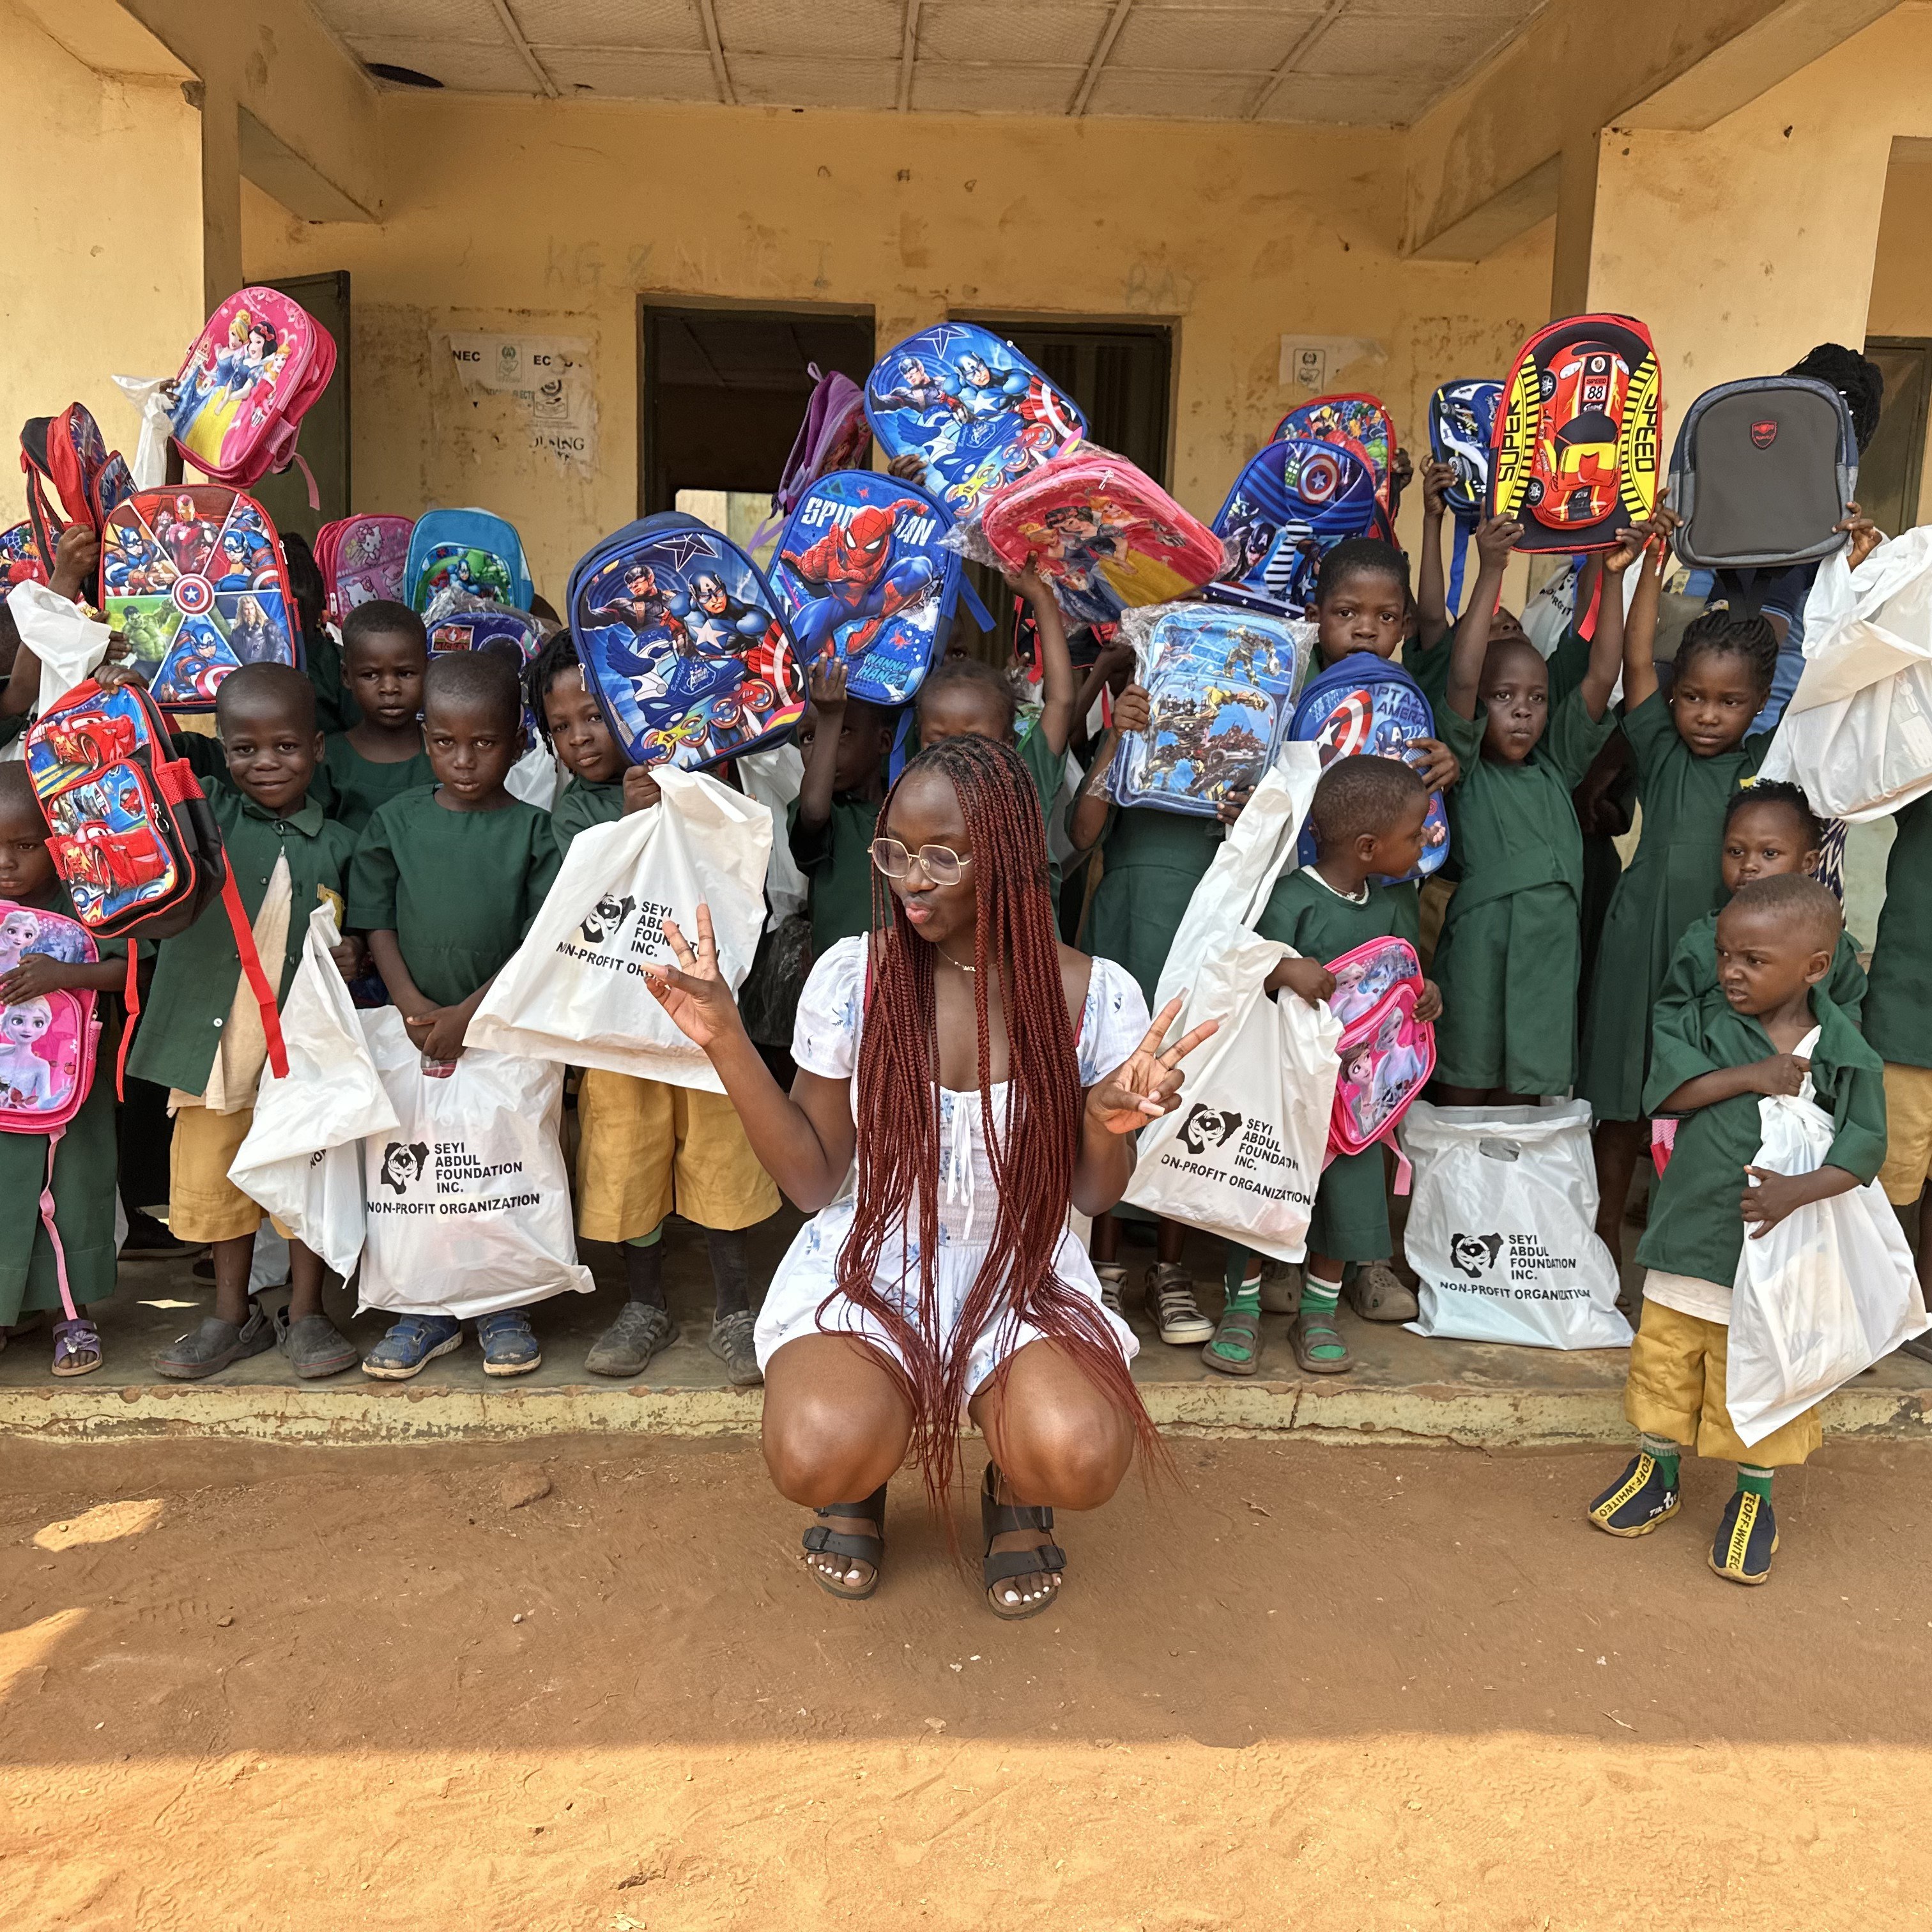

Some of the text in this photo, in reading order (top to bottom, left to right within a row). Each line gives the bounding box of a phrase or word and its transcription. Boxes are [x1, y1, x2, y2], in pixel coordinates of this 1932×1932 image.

[1587, 386, 1603, 399] 88
[1498, 399, 1521, 482] SUPER
[1634, 393, 1659, 473] SPEED
[866, 652, 908, 672] WANNA
[857, 665, 907, 687] HANG?
[641, 901, 673, 919] SEYI
[631, 940, 657, 958] INC.
[1246, 1118, 1273, 1135] SEYI
[434, 1142, 465, 1154] SEYI
[1242, 1131, 1281, 1152] ABDUL
[435, 1154, 480, 1168] ABDUL
[1234, 1155, 1257, 1170] INC.
[436, 1162, 523, 1180] FOUNDATION
[436, 1181, 464, 1193] INC.
[1229, 1176, 1311, 1206] ORGANIZATION
[367, 1193, 540, 1215] NON-PROFIT ORGANIZATION
[1508, 1234, 1537, 1245] SEYI
[1510, 1246, 1549, 1257] ABDUL
[1510, 1258, 1576, 1268] FOUNDATION
[1511, 1270, 1538, 1280] INC.
[1440, 1282, 1591, 1300] NON-PROFIT ORGANIZATION
